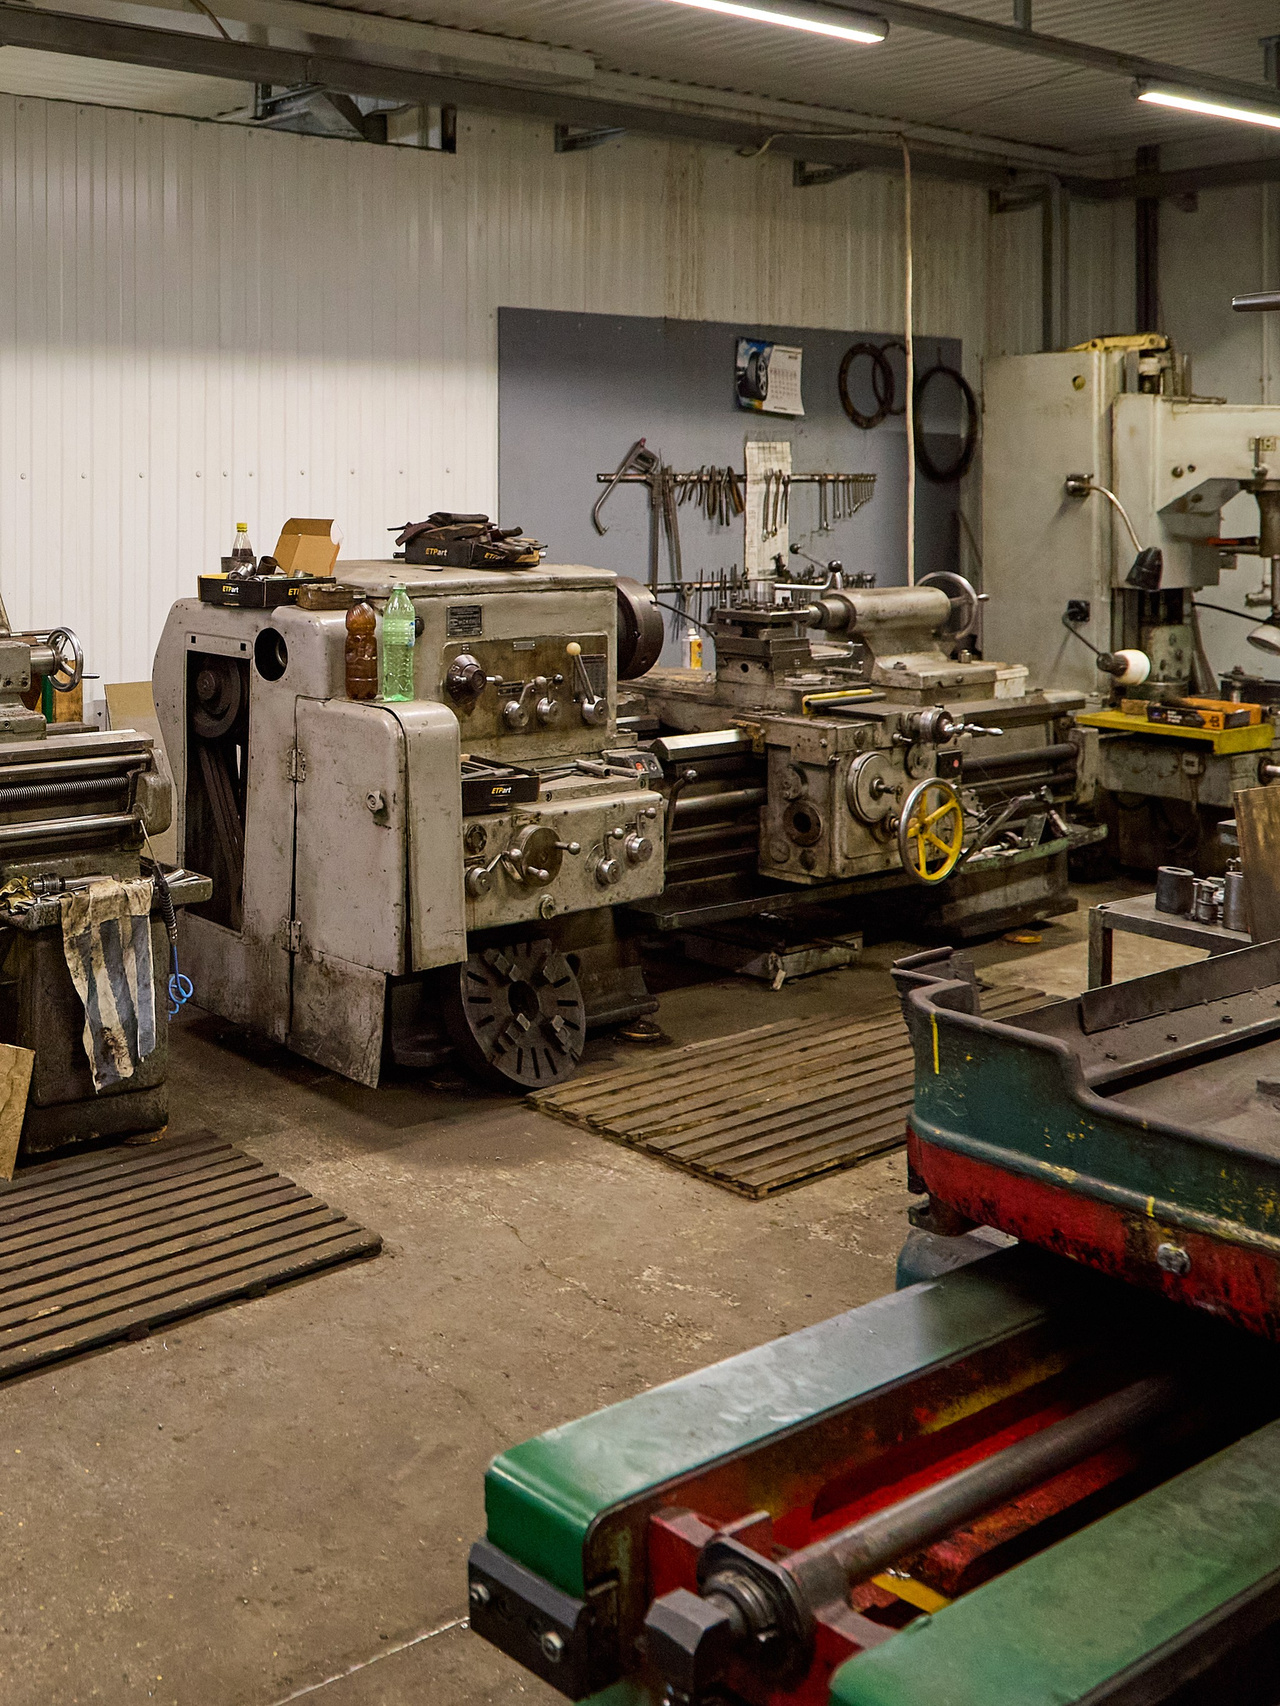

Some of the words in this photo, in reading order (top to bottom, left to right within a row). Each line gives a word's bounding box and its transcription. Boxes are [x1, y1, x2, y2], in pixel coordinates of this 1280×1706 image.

[425, 547, 448, 557] ETPart
[222, 585, 239, 594] ETPart
[491, 786, 512, 795] ETPart
